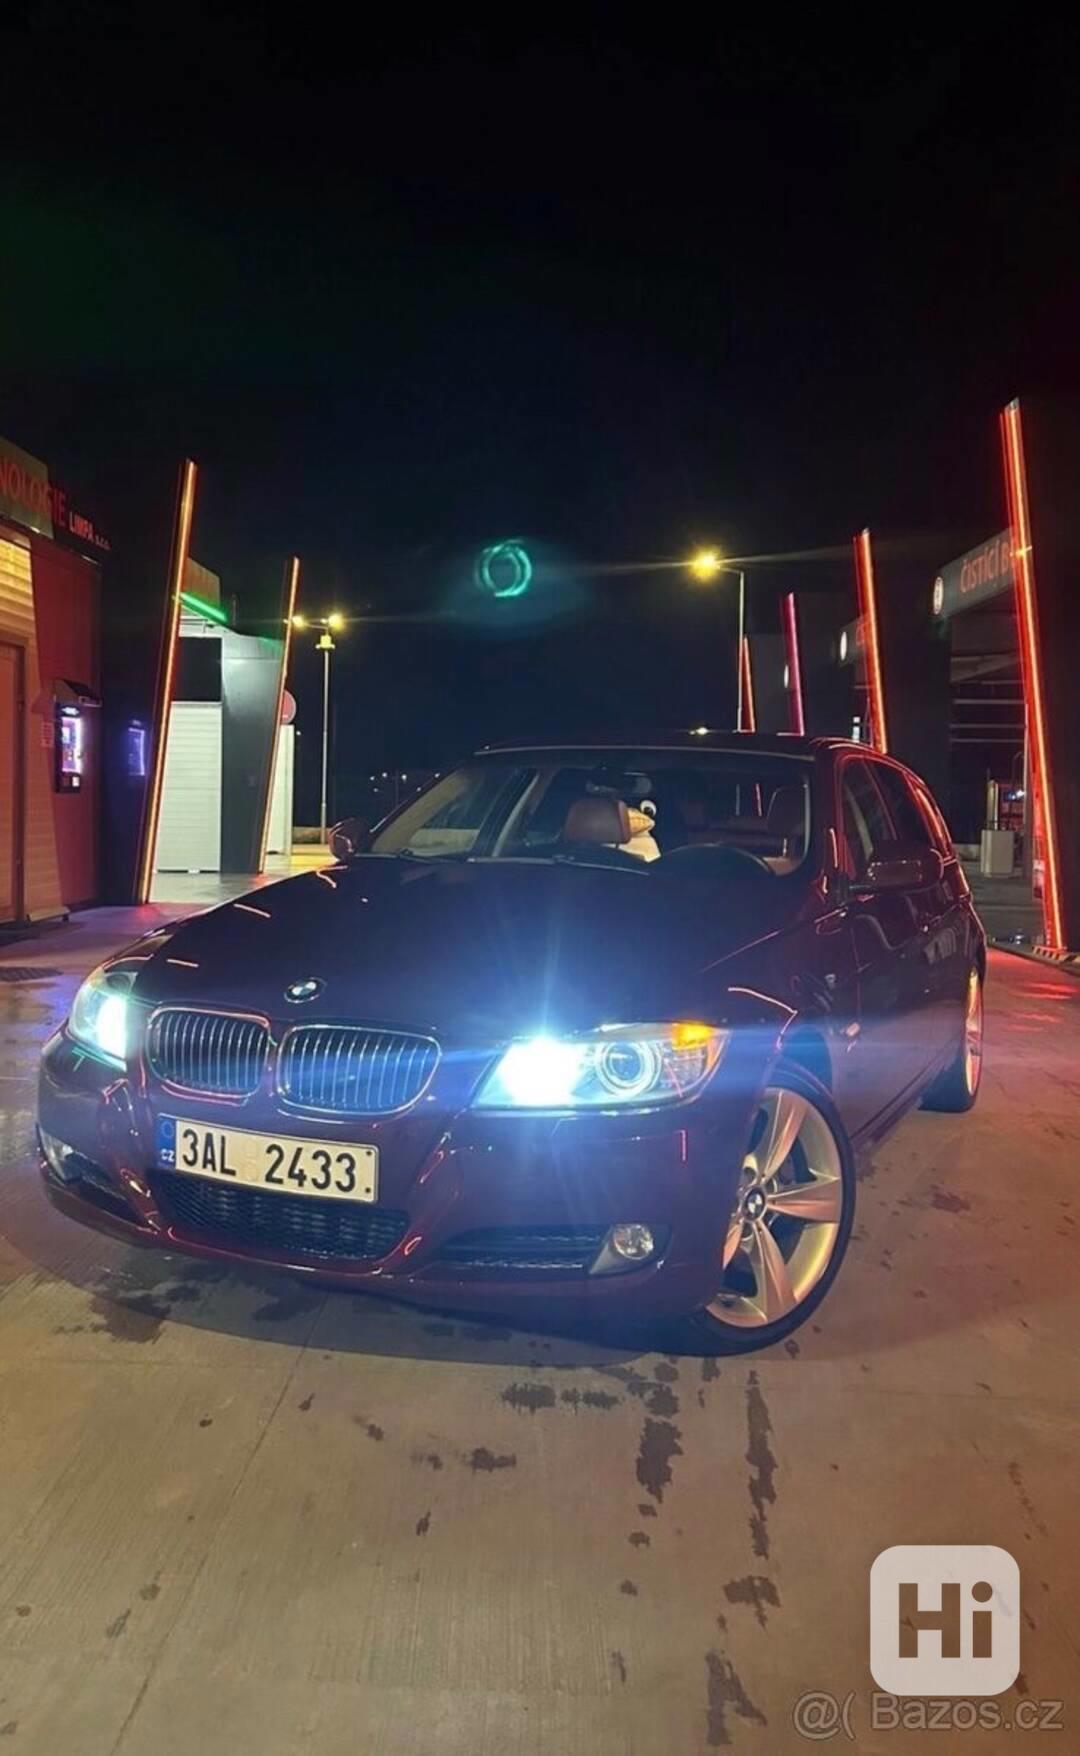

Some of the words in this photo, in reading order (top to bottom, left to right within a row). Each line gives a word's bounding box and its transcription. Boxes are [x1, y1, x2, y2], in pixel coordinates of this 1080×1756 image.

[161, 1148, 175, 1162] CZ
[182, 1128, 236, 1177] 3AL
[265, 1143, 356, 1192] 2433
